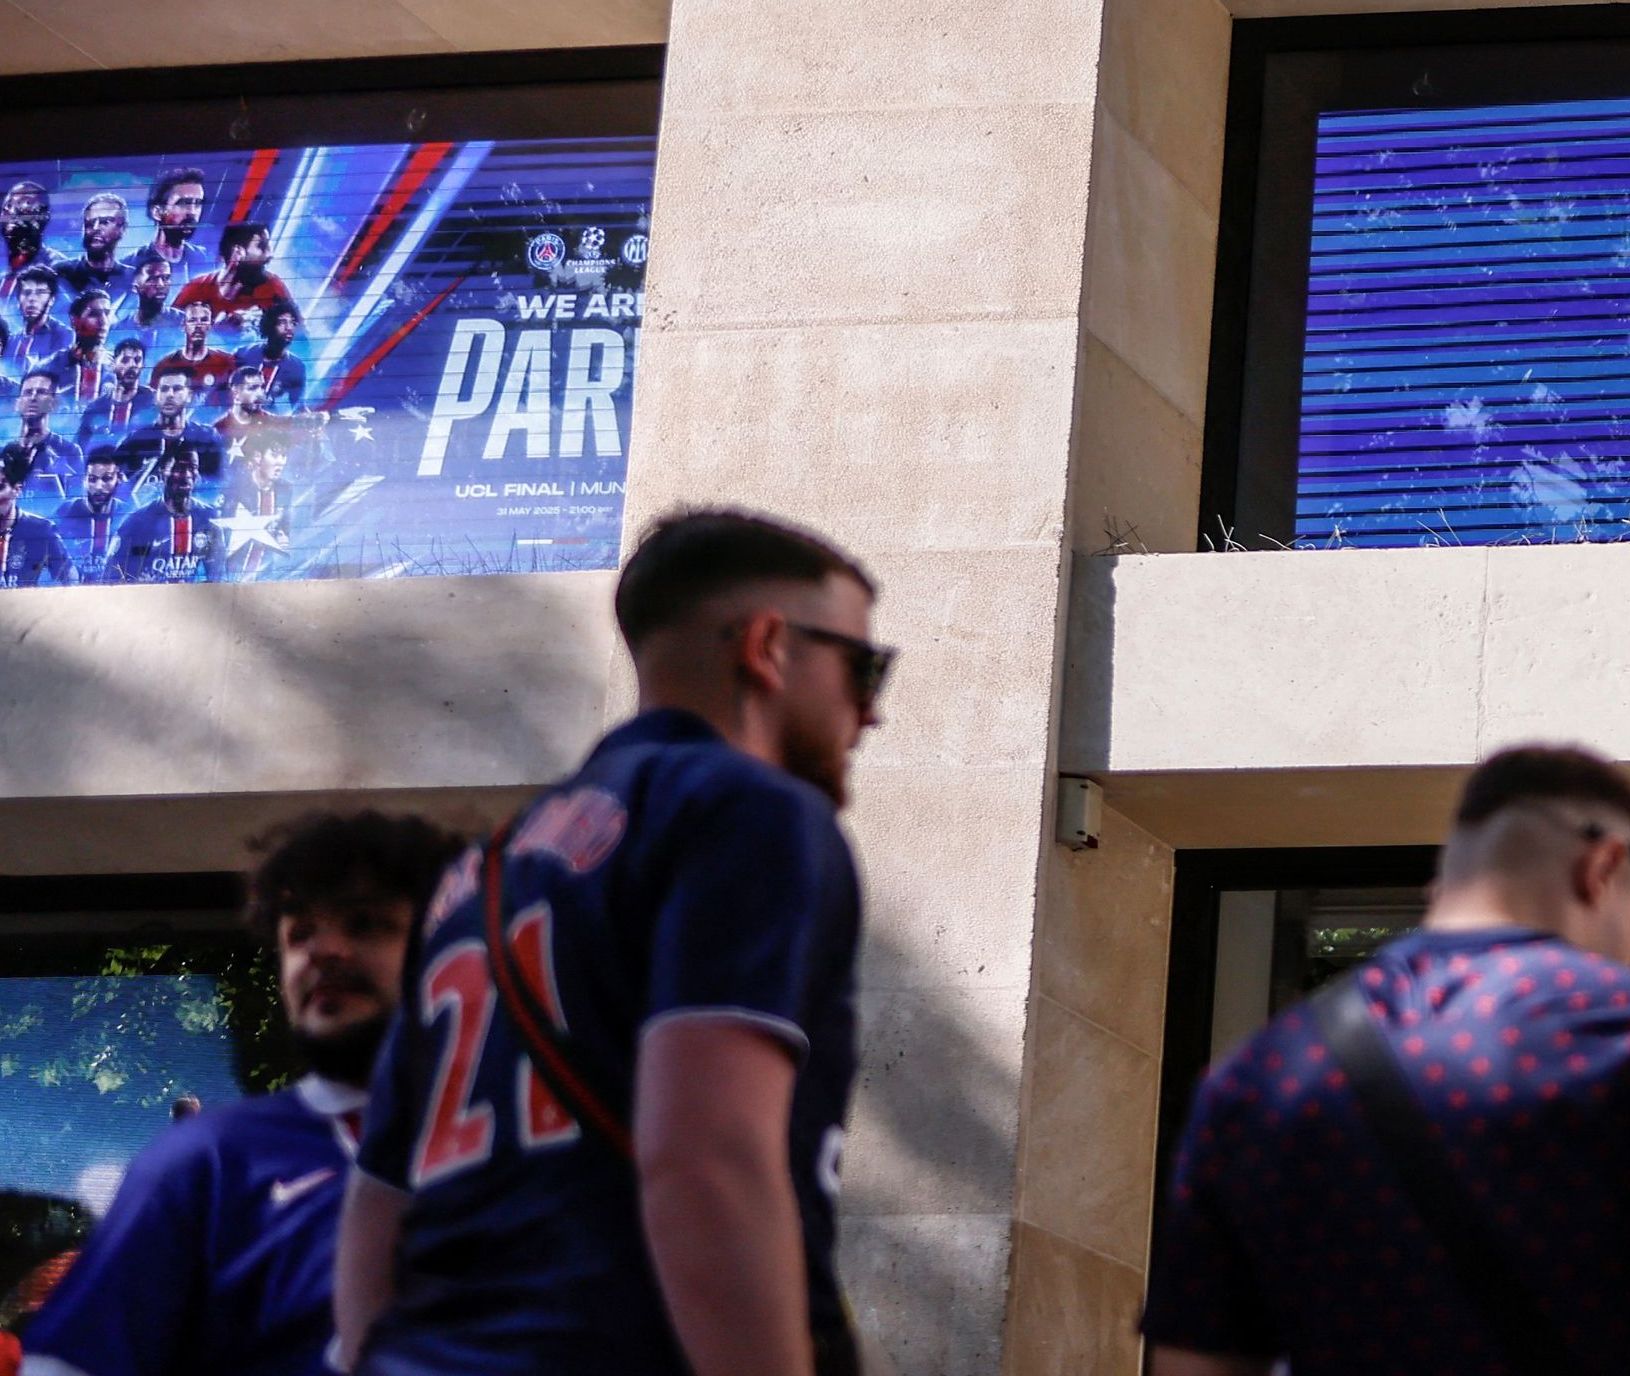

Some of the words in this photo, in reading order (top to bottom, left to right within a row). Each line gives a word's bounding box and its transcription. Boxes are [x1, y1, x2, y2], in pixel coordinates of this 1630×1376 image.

[518, 294, 577, 319] WE
[455, 484, 498, 498] UCL
[503, 482, 564, 497] FINAL
[509, 507, 532, 515] MAY
[152, 556, 199, 573] QATAR
